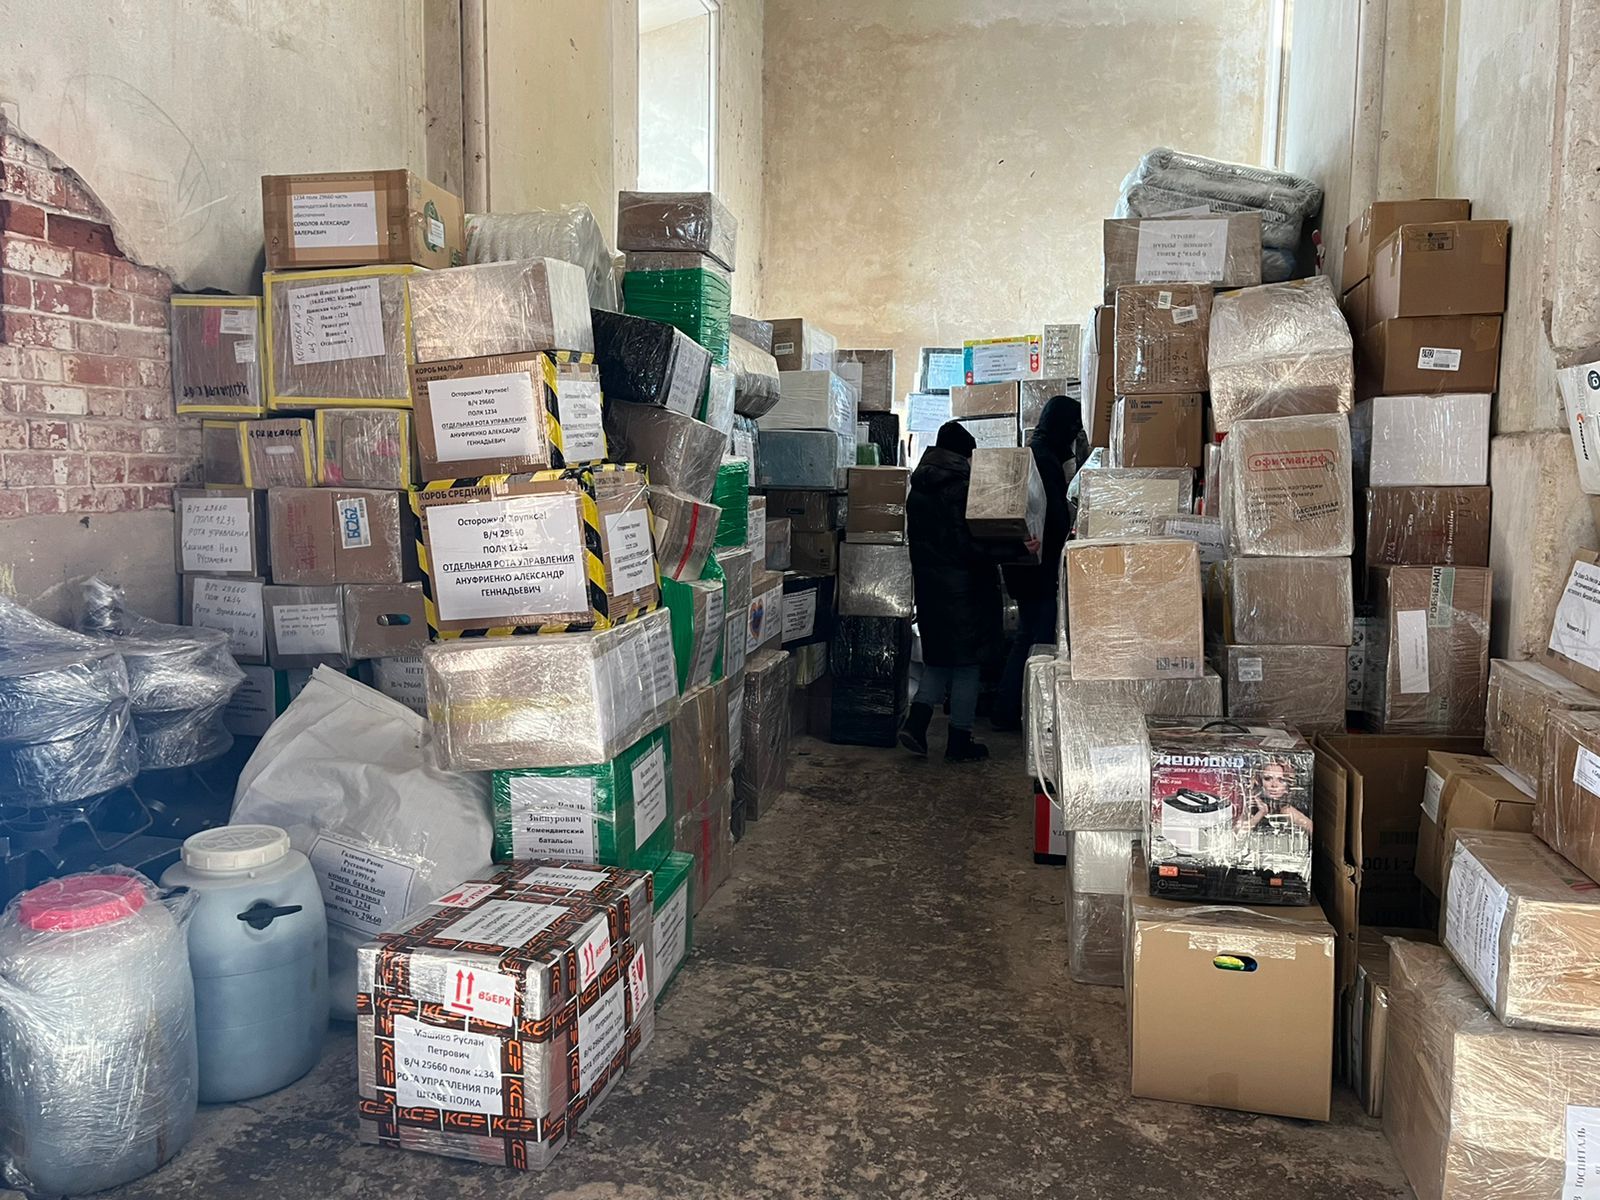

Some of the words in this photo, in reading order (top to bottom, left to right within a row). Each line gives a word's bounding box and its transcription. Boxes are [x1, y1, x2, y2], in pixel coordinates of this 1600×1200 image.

[416, 365, 436, 374] КОРОБ
[438, 362, 464, 372] МАЛЫЙ
[451, 389, 484, 398] Осторожно!
[485, 386, 509, 394] Хрупкое!
[442, 420, 474, 428] ОТДЕЛЬНАЯ
[450, 429, 487, 438] АНУФРИЕНКО
[488, 426, 521, 436] АЛЕКСАНДР
[419, 490, 447, 501] КОРОБ
[448, 486, 490, 499] СРЕДНИЙ
[458, 514, 506, 527] Осторожно!
[483, 530, 498, 539] В/Ч
[483, 545, 507, 554] ПОЛК
[509, 543, 528, 552] 1234
[443, 560, 492, 572] ОТДЕЛЬНАЯ
[494, 558, 516, 568] РОТА
[518, 554, 575, 567] УПРАВЛЕНИЯ
[456, 574, 512, 585] АНУФРИЕНКО
[514, 570, 565, 581] АЛЕКСАНДР
[482, 586, 541, 597] ГЕННАДЬЕВИЧ
[1158, 756, 1244, 768] REDMOND
[352, 879, 385, 895] батальон
[478, 990, 511, 1006] ВВЕРХ
[413, 1028, 450, 1042] Машико
[453, 1034, 484, 1047] Руслан
[427, 1045, 470, 1060] Петрович
[404, 1057, 420, 1068] В/Ч
[450, 1065, 470, 1075] полк
[397, 1071, 420, 1084] РОА
[422, 1076, 481, 1093] УПРАВЛЕНИЯ
[483, 1086, 503, 1096] ПРИ
[417, 1090, 447, 1102] ШТАБЕ
[449, 1094, 482, 1107] ПОЛКА
[1575, 1128, 1586, 1188] ГОСПИТАЛЬ
